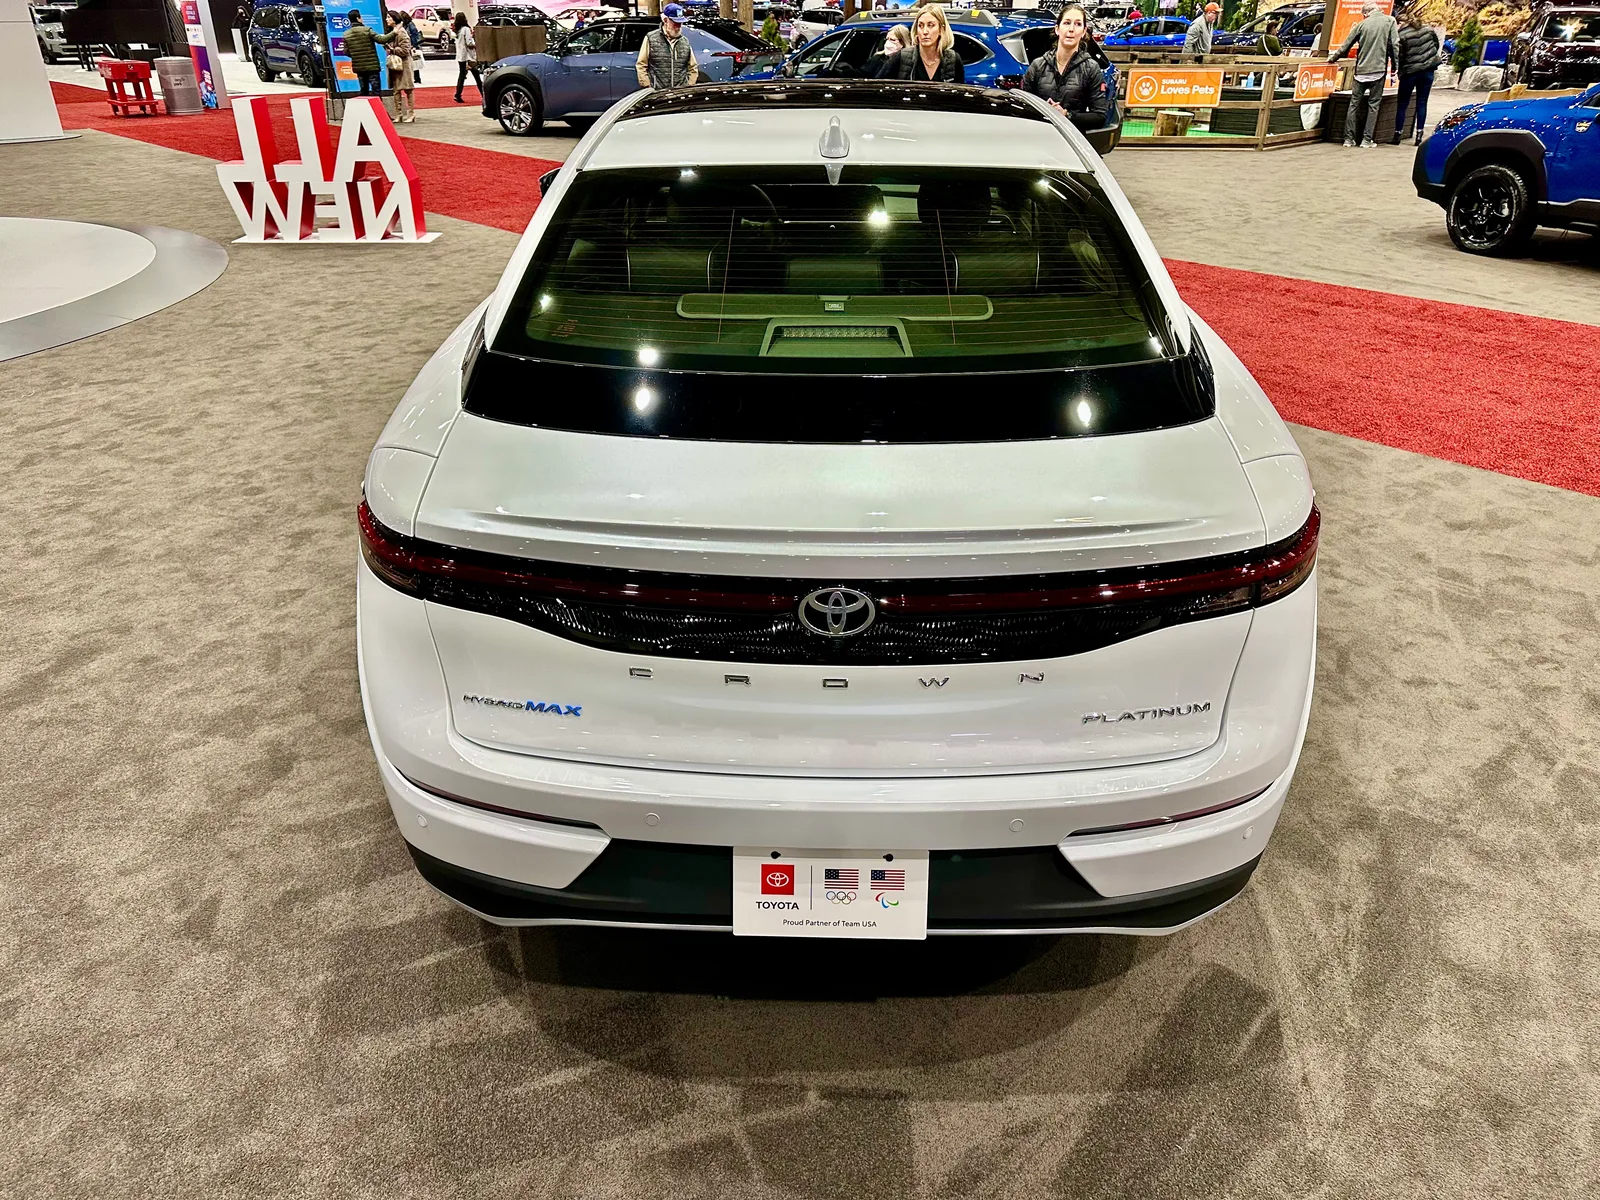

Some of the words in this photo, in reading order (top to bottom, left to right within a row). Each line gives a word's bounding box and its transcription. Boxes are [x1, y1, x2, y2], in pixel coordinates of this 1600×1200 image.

[1160, 85, 1191, 95] Loves
[1192, 85, 1215, 95] Pets
[629, 667, 1045, 688] CROWN
[1082, 701, 1211, 724] PLATINUM
[756, 901, 800, 910] TOYOTA
[805, 919, 831, 927] Partner
[832, 919, 841, 927] of
[861, 920, 877, 928] USA
